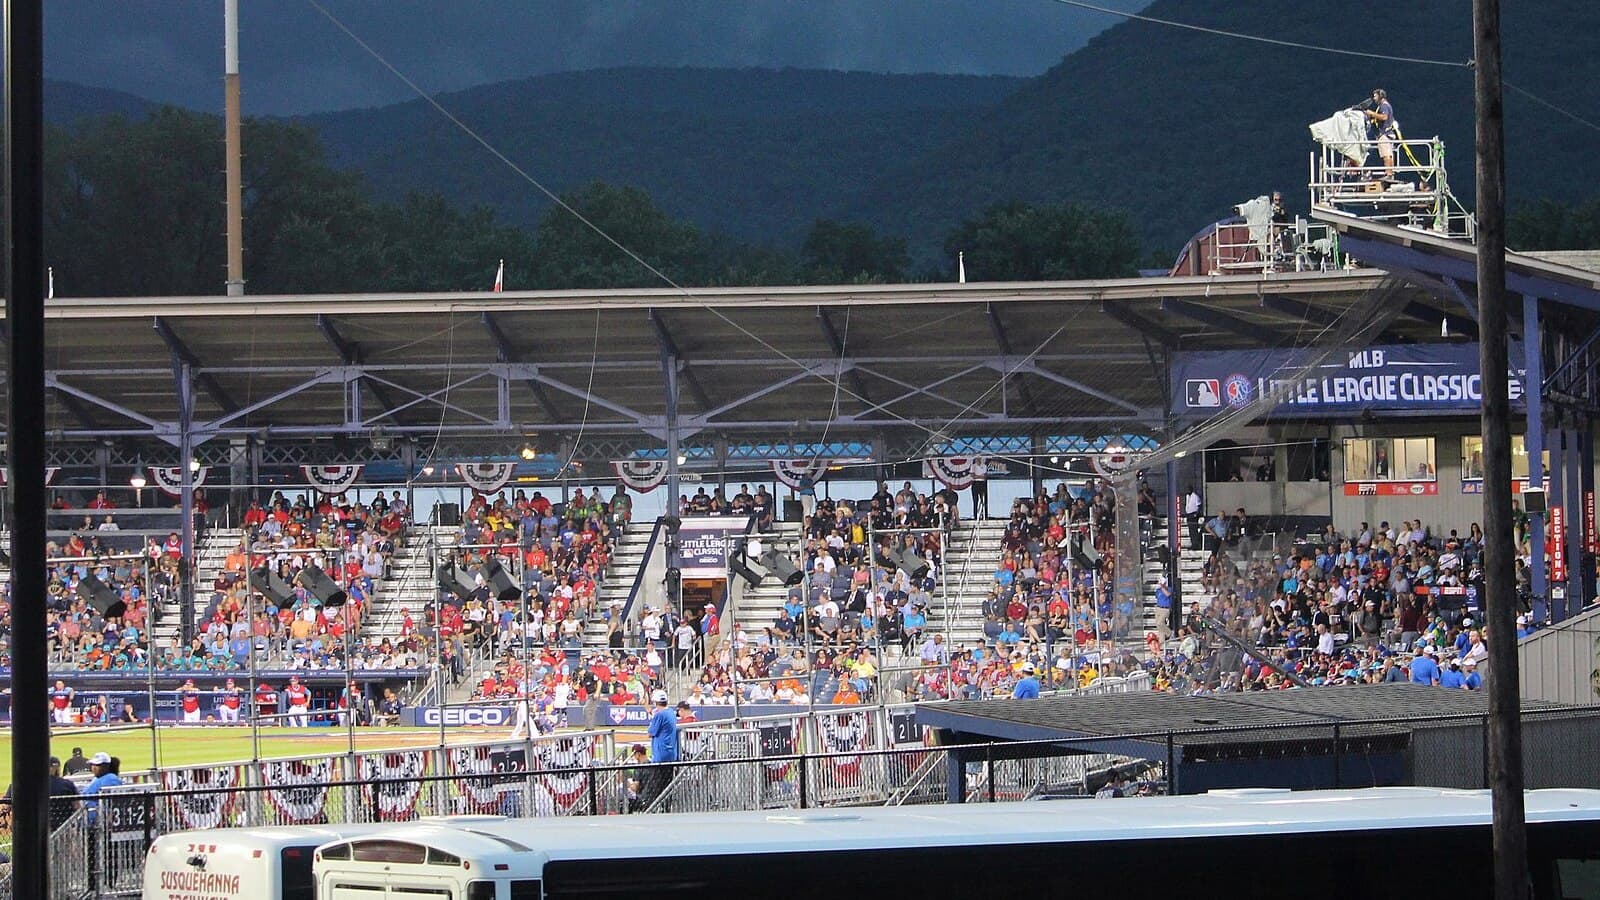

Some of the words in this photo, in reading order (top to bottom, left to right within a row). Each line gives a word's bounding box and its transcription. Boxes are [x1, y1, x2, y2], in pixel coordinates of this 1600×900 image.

[1349, 350, 1384, 369] MLB
[1322, 375, 1397, 403] LEAGUE
[1400, 372, 1482, 401] CLASSIC
[1553, 508, 1562, 569] SECTION
[1555, 571, 1561, 580] 7
[424, 708, 502, 725] GEICO
[626, 711, 647, 721] MLB
[899, 723, 905, 740] 2
[913, 723, 918, 738] 1
[160, 870, 241, 894] SUSQUEHANNA
